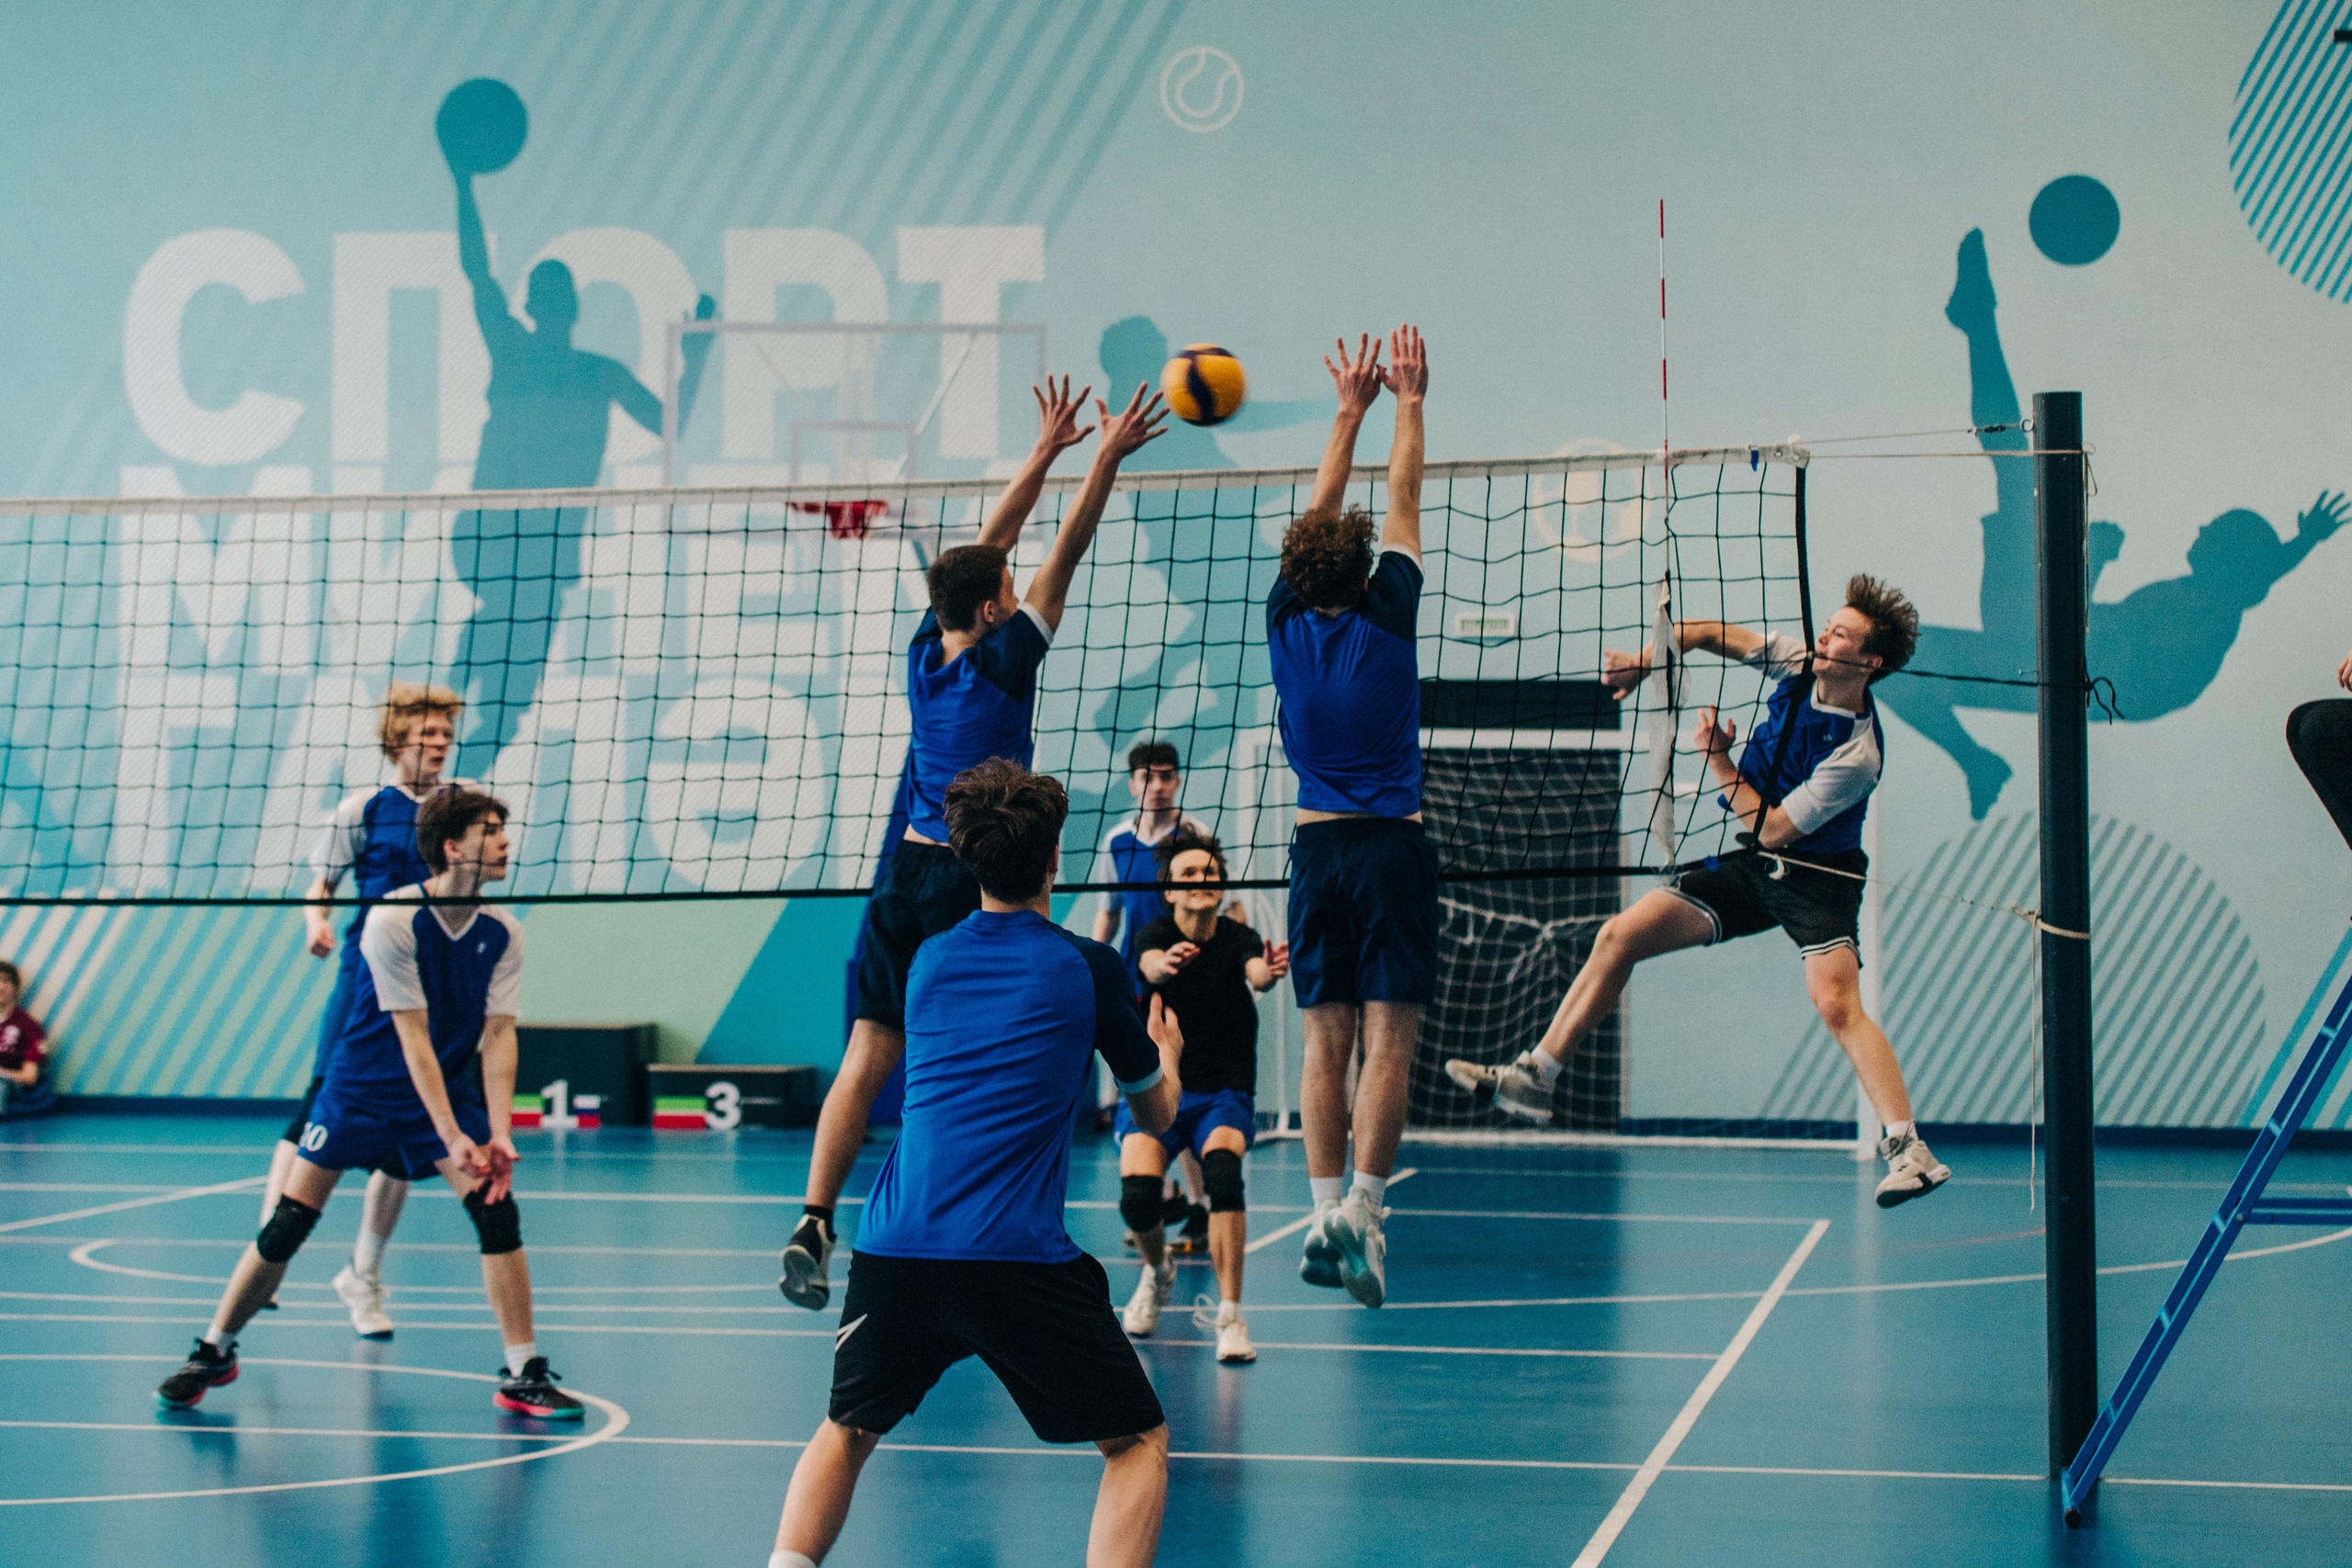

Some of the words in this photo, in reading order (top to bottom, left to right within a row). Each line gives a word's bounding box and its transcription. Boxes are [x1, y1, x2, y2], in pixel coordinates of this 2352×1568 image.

[123, 225, 1046, 465] СПОРТ
[540, 1079, 578, 1128] 1
[705, 1081, 741, 1130] 3
